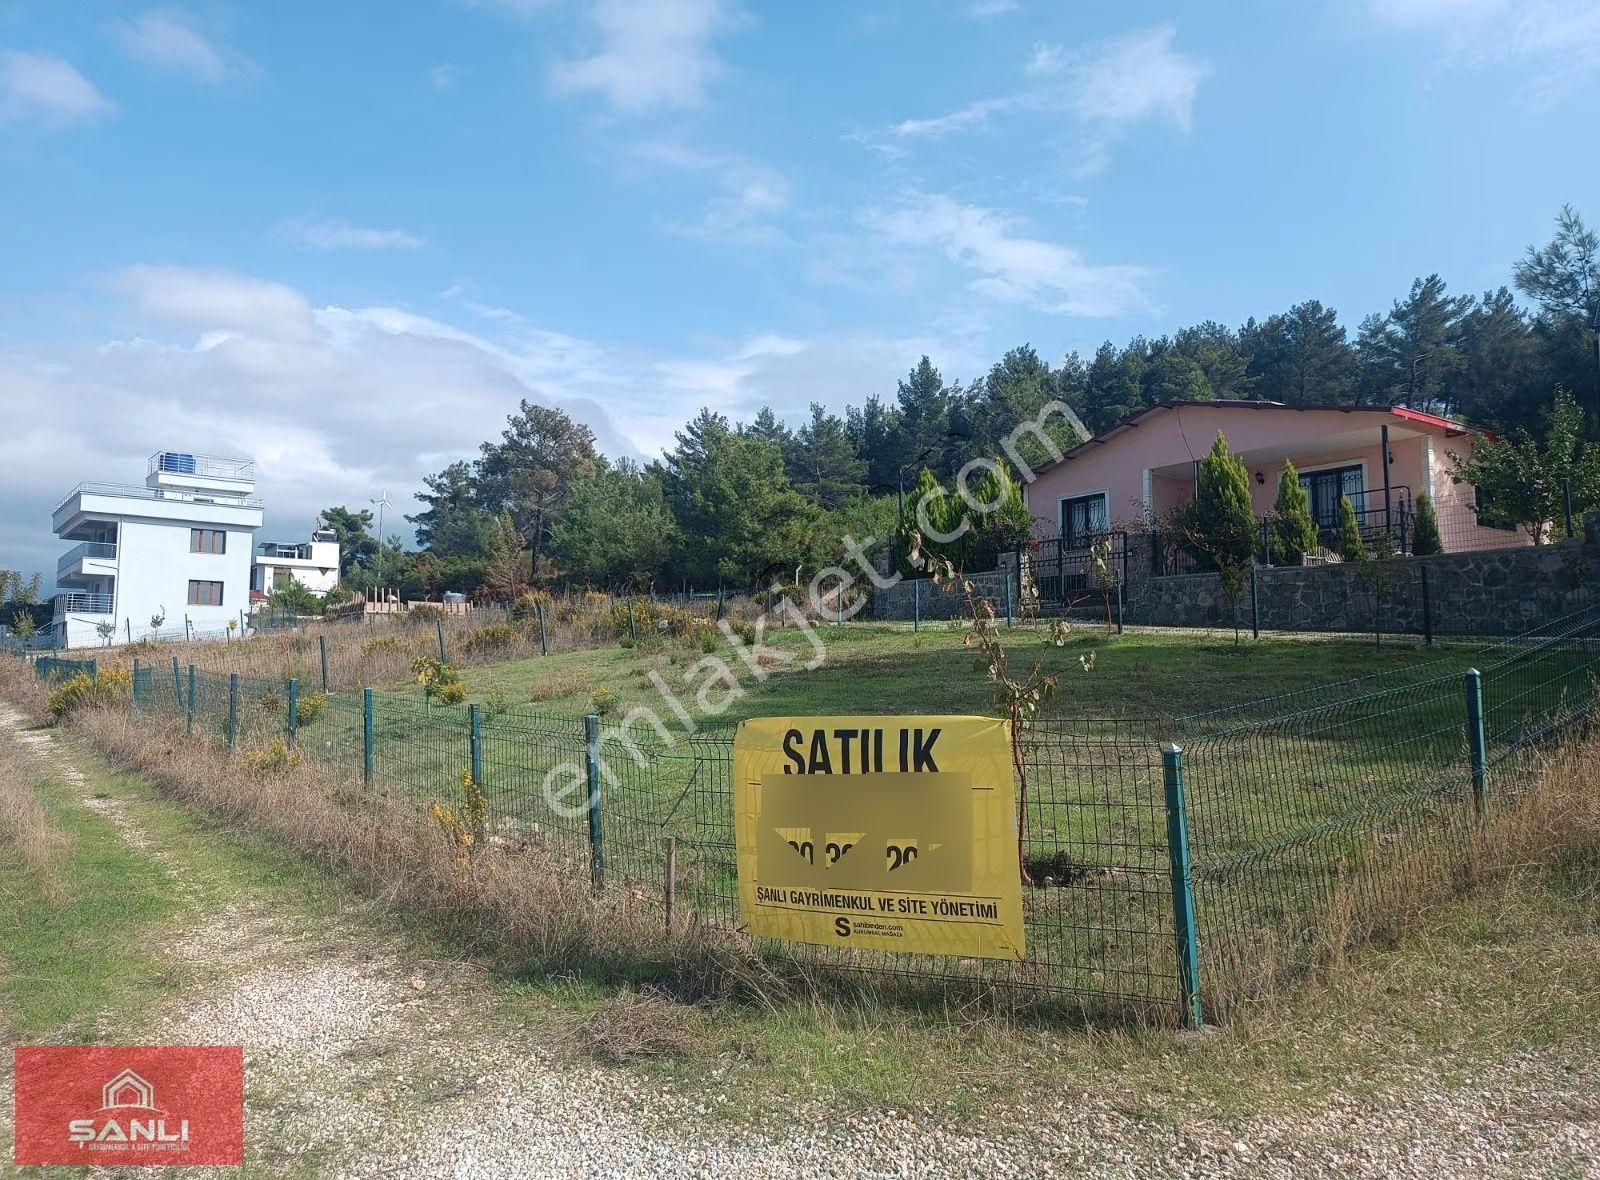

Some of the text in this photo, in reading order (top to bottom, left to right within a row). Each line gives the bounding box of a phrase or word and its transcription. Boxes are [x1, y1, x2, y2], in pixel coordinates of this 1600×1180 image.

[757, 887, 998, 919] ŞANLI GAYRİMENKUL VE SİTE YÖNETİMİ
[853, 922, 903, 931] sahibinden.com
